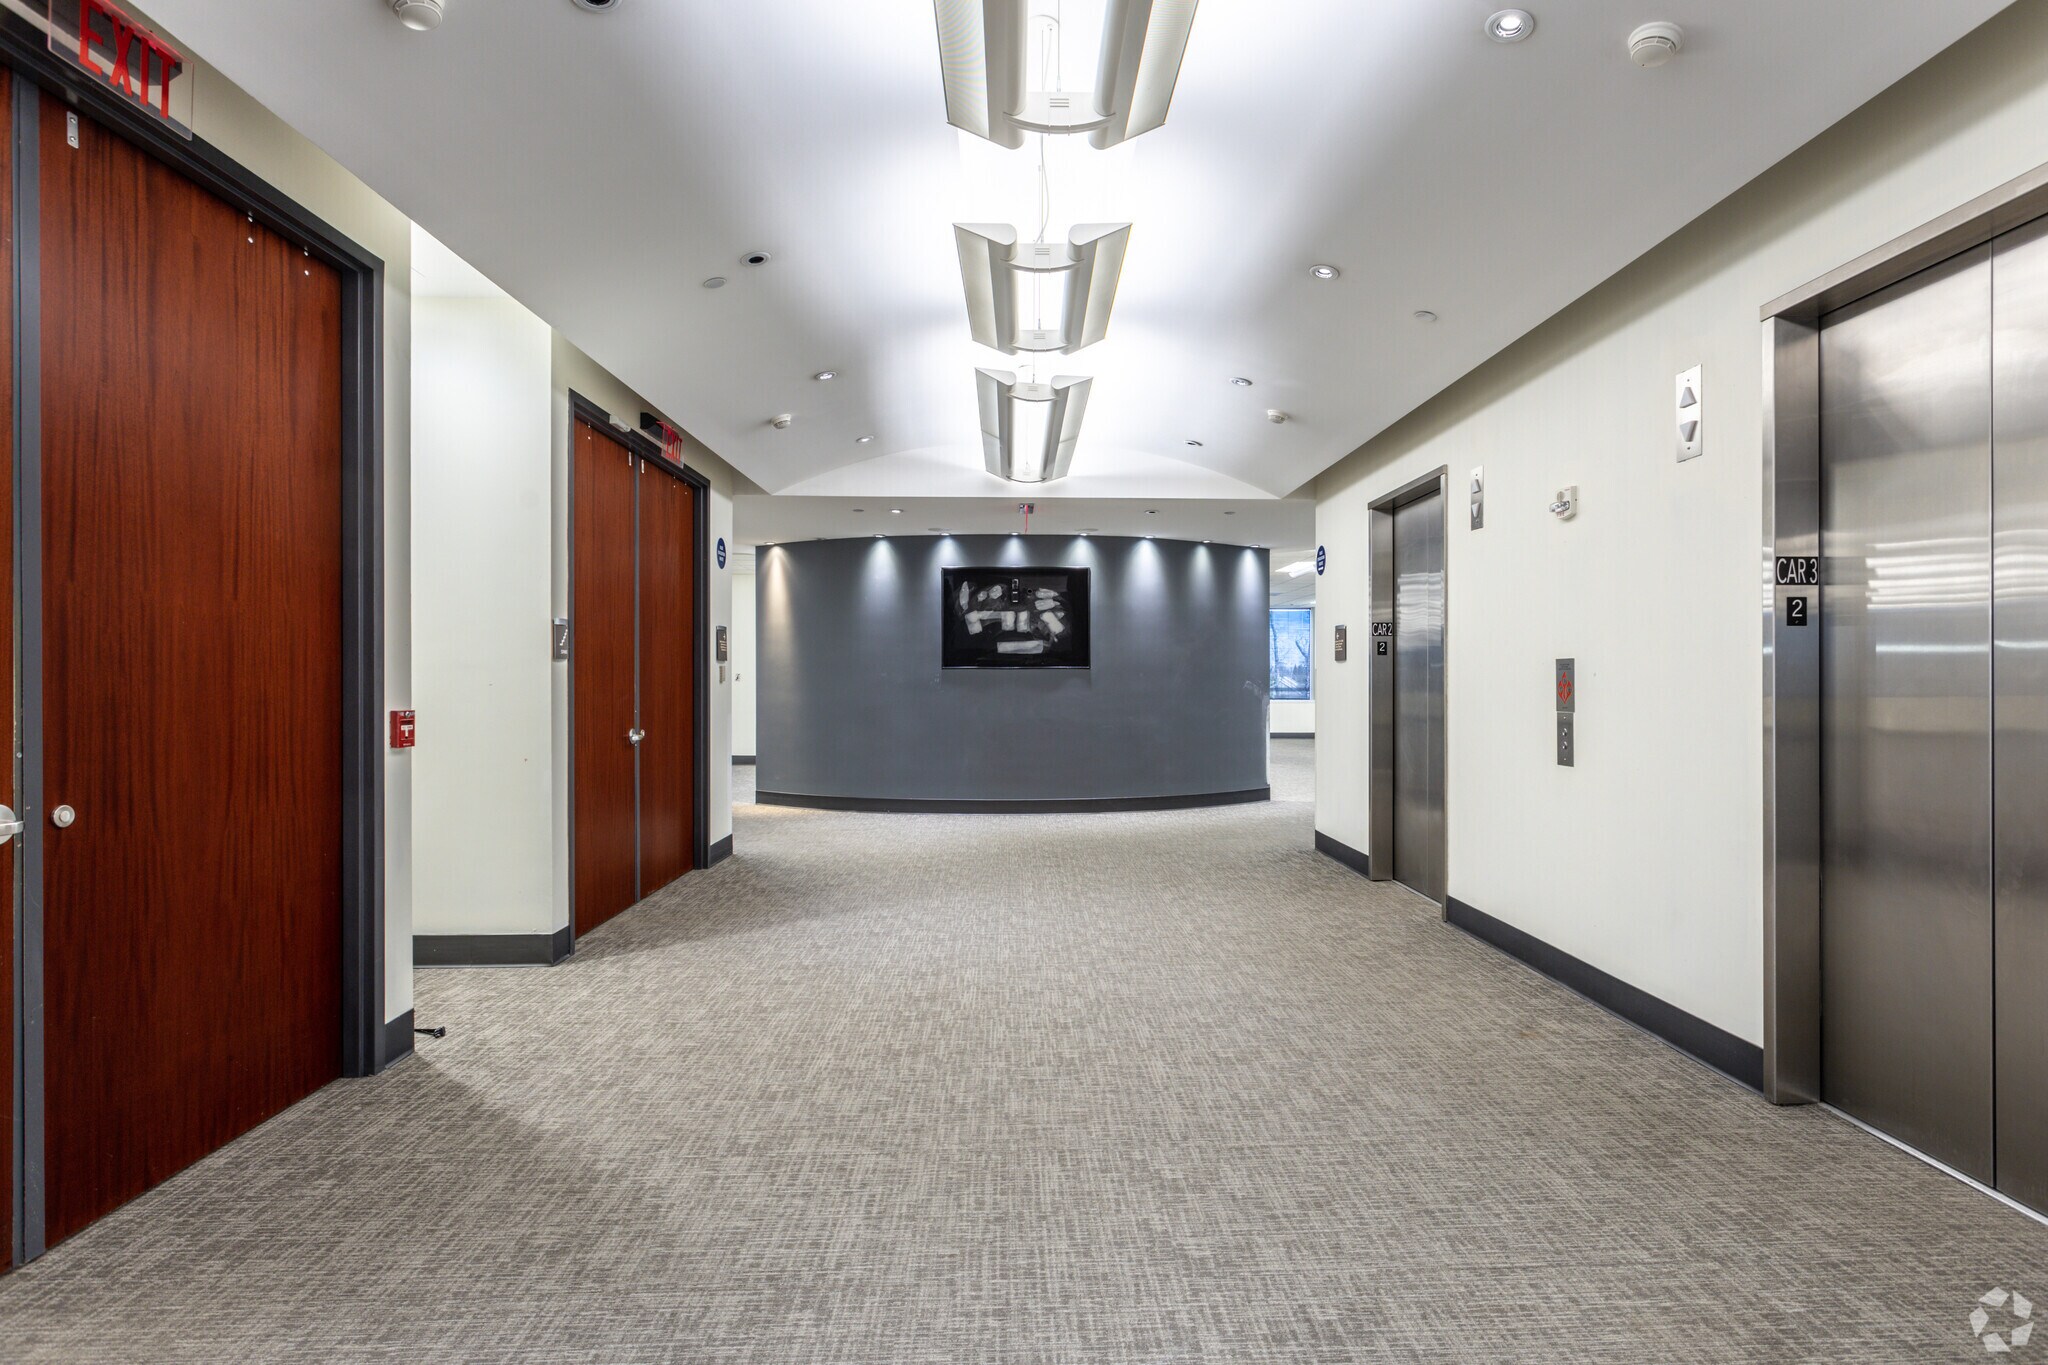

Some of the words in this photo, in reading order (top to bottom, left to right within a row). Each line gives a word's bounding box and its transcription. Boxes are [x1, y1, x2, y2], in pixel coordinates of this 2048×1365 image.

[79, 0, 176, 120] EXIT
[1776, 558, 1807, 584] CAR
[1809, 558, 1818, 584] 3
[1791, 599, 1803, 617] 2
[1372, 623, 1387, 636] CAR
[1387, 623, 1393, 636] 2
[1379, 642, 1386, 652] 2
